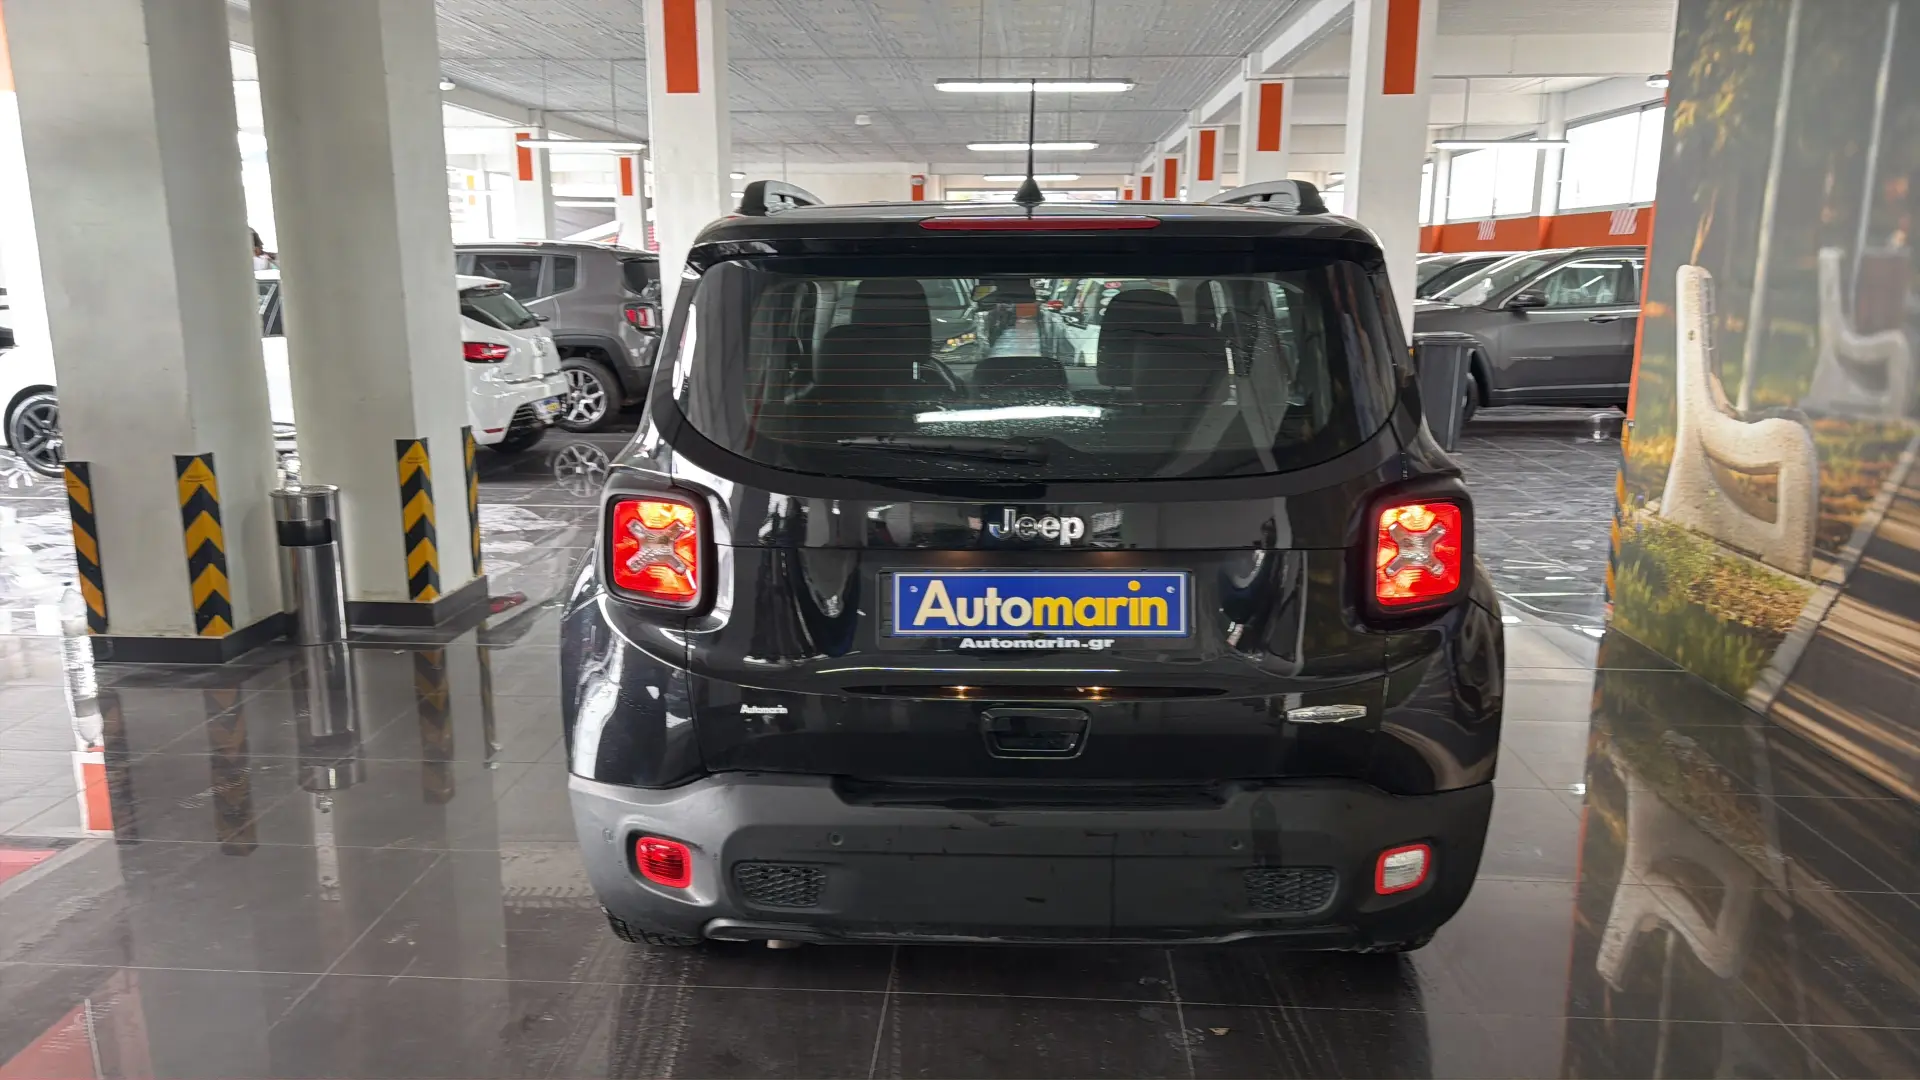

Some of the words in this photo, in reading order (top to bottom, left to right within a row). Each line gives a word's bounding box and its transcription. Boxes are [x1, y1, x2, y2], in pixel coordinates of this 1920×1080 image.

[988, 508, 1085, 546] Jeep
[912, 579, 1168, 627] Automarin
[959, 637, 1115, 650] Automarin.gr
